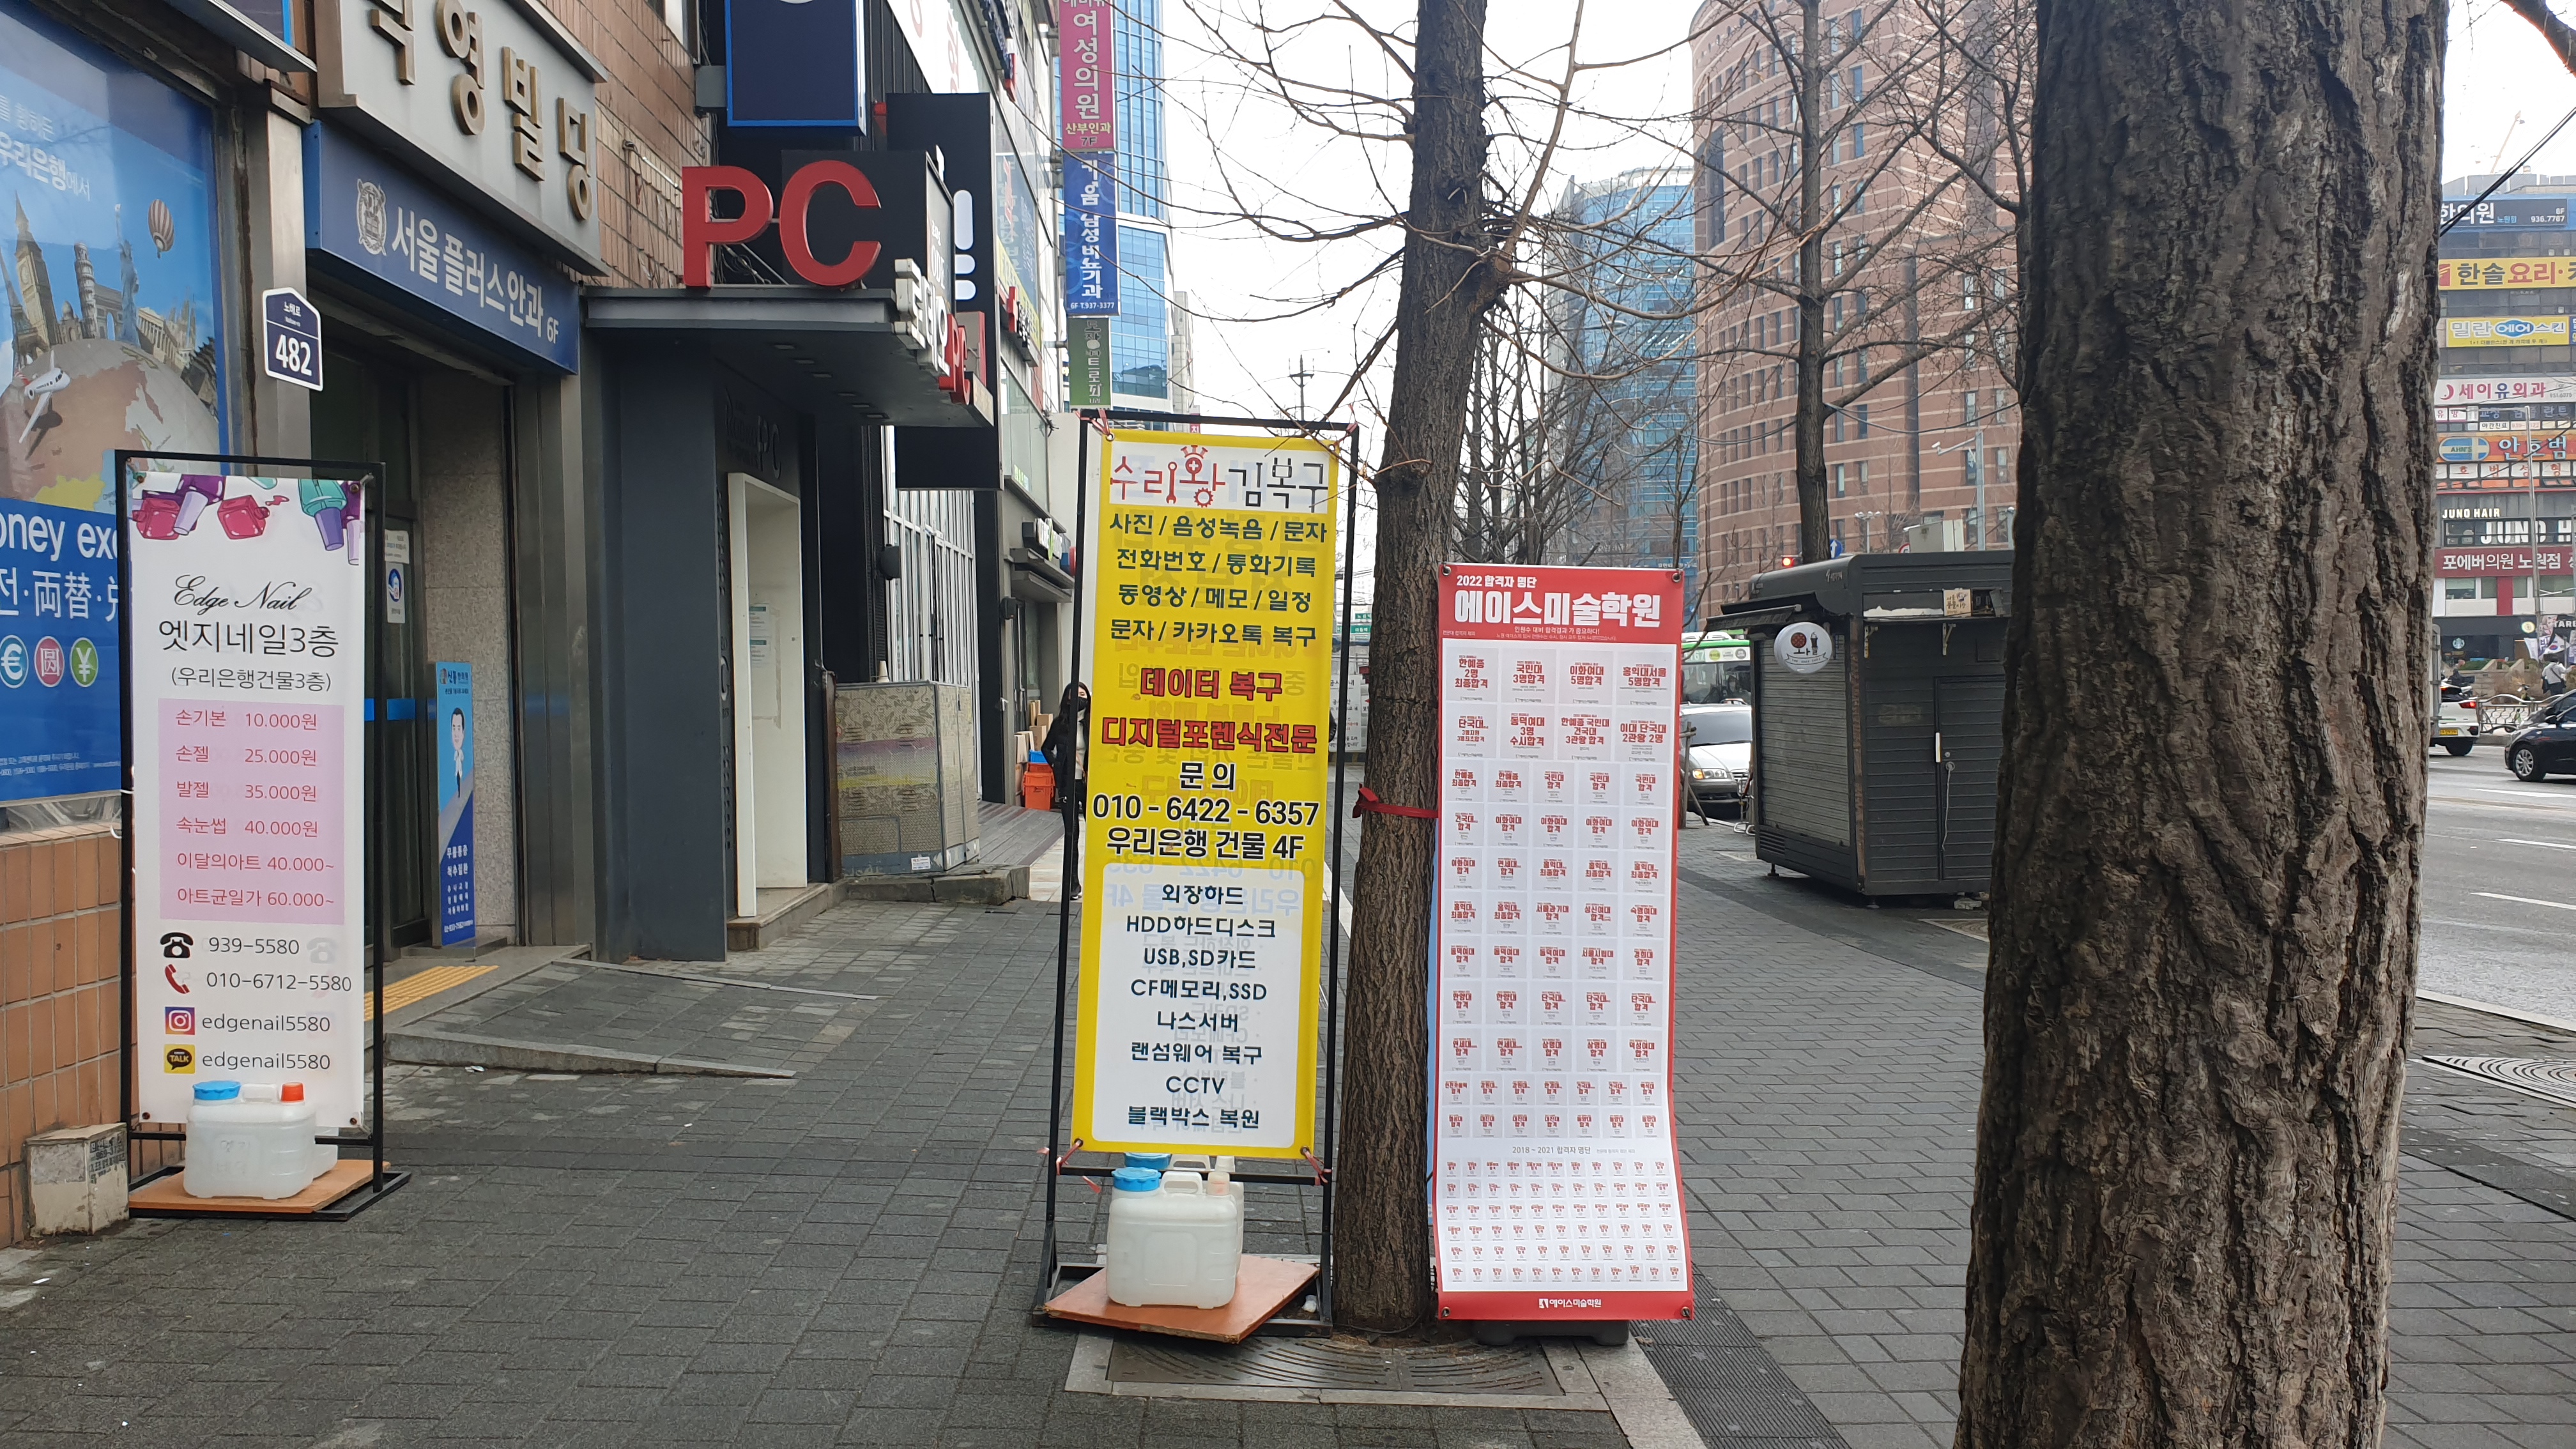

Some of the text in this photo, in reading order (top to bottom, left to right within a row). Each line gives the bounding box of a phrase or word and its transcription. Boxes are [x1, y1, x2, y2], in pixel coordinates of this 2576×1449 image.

[1073, 10, 1100, 119] 여성의원
[1065, 122, 1112, 135] 산부인과
[1080, 137, 1098, 147] 7F
[682, 160, 882, 287] PC
[2440, 203, 2494, 224] 한의원
[1080, 213, 1103, 298] 남성비뇨기과
[392, 206, 559, 344] 서울플러스안과 6F
[275, 334, 312, 376] 482
[2459, 382, 2546, 399] 세이유외과
[2442, 508, 2501, 519] JUNO HAIR
[1109, 513, 1153, 535] 사진
[1173, 516, 1262, 541] 음성녹음
[1284, 521, 1327, 543] 문자
[1117, 548, 1206, 572] 전화번호
[1226, 553, 1316, 578] 통화기록
[2442, 553, 2513, 571] 포에버의원
[1456, 574, 1538, 588] 2022 합격자 명단
[174, 574, 312, 616] Edge Nail
[1118, 583, 1187, 608] 동영상
[1205, 588, 1248, 609] 메모
[1268, 590, 1311, 613] 일정
[1454, 589, 1661, 628] 에이스미술학원
[158, 620, 339, 658] 엣지네일3층
[1110, 618, 1154, 642] 문자
[1172, 621, 1262, 645] 카카오톡
[1273, 625, 1317, 648] 복구
[1459, 658, 1485, 669] 한예종
[1464, 669, 1478, 678] 2명
[1516, 664, 1543, 675] 국민대
[1570, 665, 1604, 676] 이화여대
[171, 667, 332, 692] (우리은행건물3층)
[1140, 668, 1283, 702] 데이터 복구
[1455, 678, 1488, 688] 최종합격
[1513, 674, 1545, 684] 3명합격
[1570, 675, 1602, 686] 5명합격
[1628, 677, 1660, 687] 5명합격
[176, 709, 318, 732] 손기본 10.000원
[1459, 719, 1484, 729] 단국대
[1510, 716, 1545, 726] 동덕여대
[1520, 726, 1534, 736] 3명
[1561, 717, 1609, 728] 한예종 국민대
[1620, 723, 1667, 734] 이대 단국대
[1101, 717, 1317, 754] 디지털포렌식전문
[1510, 736, 1544, 746] 수시합격
[1588, 736, 1604, 745] 합격
[1648, 734, 1664, 744] 2명
[176, 745, 317, 767] 손젤 25.000원
[176, 780, 317, 802] 발젤 35.000원
[176, 816, 318, 838] 속눈썹 40.000원
[1106, 827, 1305, 861] 우리은행 건물 4F
[177, 852, 261, 871] 이달의아트
[177, 887, 262, 907] 아트균일가
[1162, 884, 1244, 906] 외장하드
[1126, 915, 1276, 938] HDD하드디스크
[208, 935, 301, 956] 939-5580
[1143, 947, 1257, 970] USB,SD카드
[205, 970, 353, 993] 010-6712-5580
[1130, 978, 1268, 1002] CF메모리,SSD
[201, 1013, 332, 1035] edgenail5580
[1157, 1010, 1239, 1032] 나스서버
[169, 1054, 190, 1063] TALK
[202, 1051, 332, 1072] edgenail5580
[1130, 1041, 1263, 1066] 랜섬웨어 복구
[1165, 1076, 1225, 1094] CCTV
[1128, 1105, 1260, 1130] 블랙박스 복원
[1556, 1146, 1576, 1155] 합격자
[1578, 1146, 1591, 1154] 명단
[1549, 1298, 1602, 1308] 에이스미술학원
